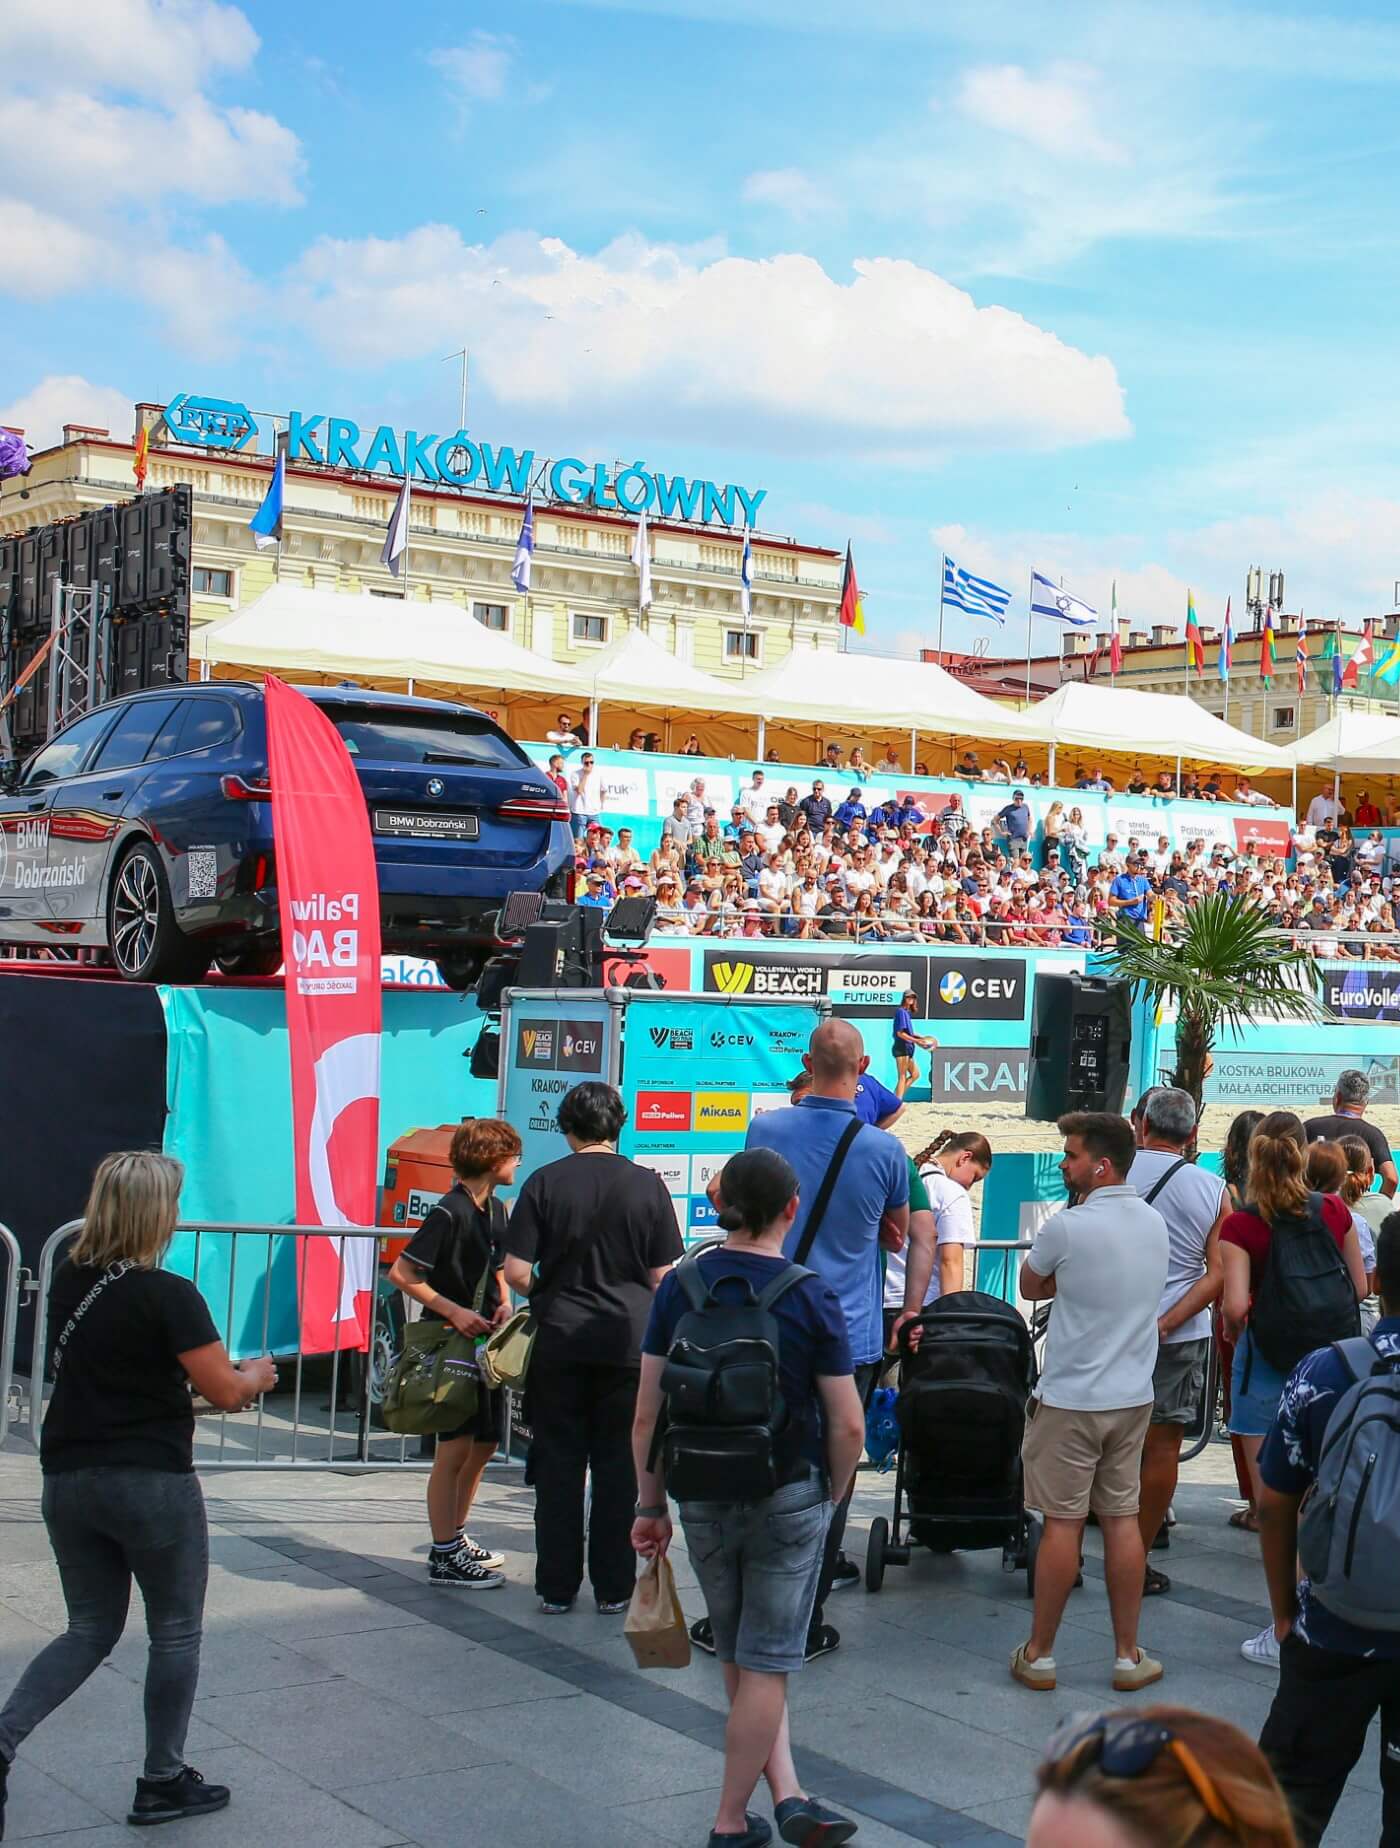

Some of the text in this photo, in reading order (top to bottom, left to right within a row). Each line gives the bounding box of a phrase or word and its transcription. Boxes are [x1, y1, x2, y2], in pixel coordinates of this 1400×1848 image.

[180, 409, 244, 435] PKP
[289, 410, 768, 528] KRAKÓW GŁÓWNY
[389, 815, 466, 830] BMW Dobrzański
[16, 820, 50, 849] BMW
[1180, 825, 1215, 836] Polbruk
[15, 856, 85, 889] Dobrzański
[755, 965, 798, 974] VOLLEYBALL
[753, 974, 822, 992] BEACH
[842, 976, 897, 988] EUROPE
[971, 978, 1016, 998] CEV
[844, 992, 893, 1003] FUTURES
[671, 1029, 694, 1037] BEACH
[575, 1040, 596, 1054] CEV
[728, 1035, 754, 1046] CEV
[1218, 1065, 1325, 1078] KOSTKA BRUKOWA
[531, 1079, 568, 1094] KRAKOW
[1218, 1083, 1250, 1095] MAŁA
[662, 1111, 685, 1119] Paliwa
[530, 1118, 548, 1130] ORLEN
[59, 1274, 114, 1345] FASHION BAG
